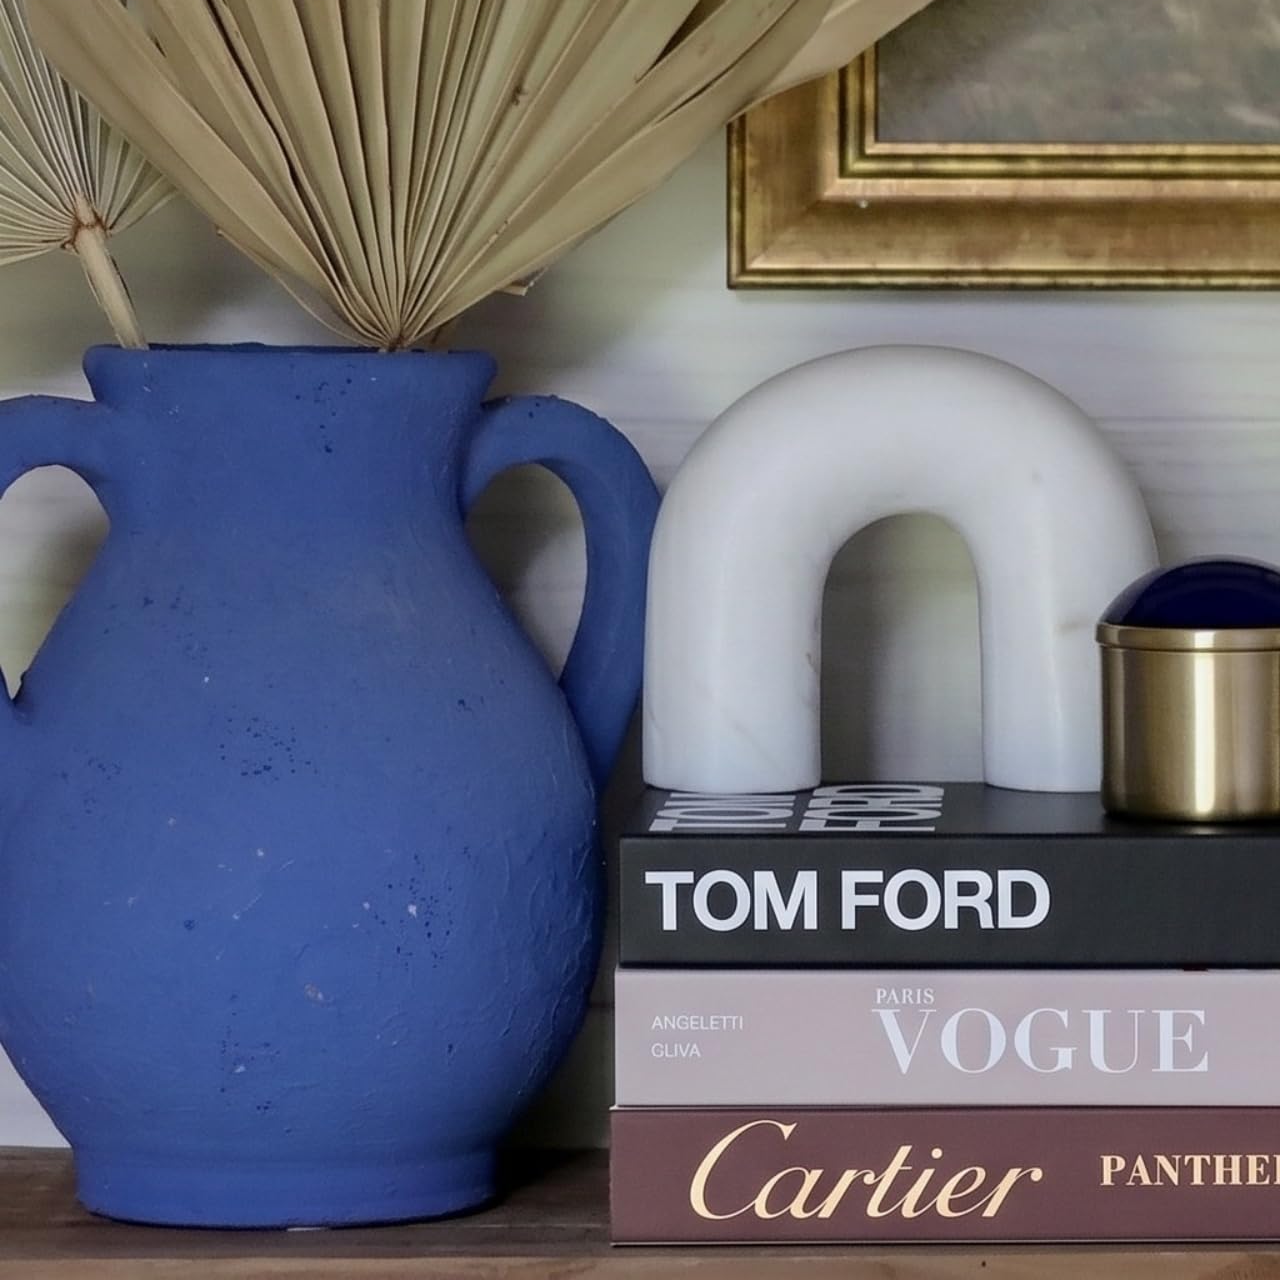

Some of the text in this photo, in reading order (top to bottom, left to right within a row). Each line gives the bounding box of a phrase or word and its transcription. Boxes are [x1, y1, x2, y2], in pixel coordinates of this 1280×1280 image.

[644, 868, 1050, 932] TOM FORD
[876, 988, 935, 1005] PARIS
[651, 1015, 743, 1031] ANGELETTI
[871, 1007, 1209, 1075] VOGUE
[651, 1042, 701, 1058] GLIVA
[689, 1119, 1043, 1220] Cartier
